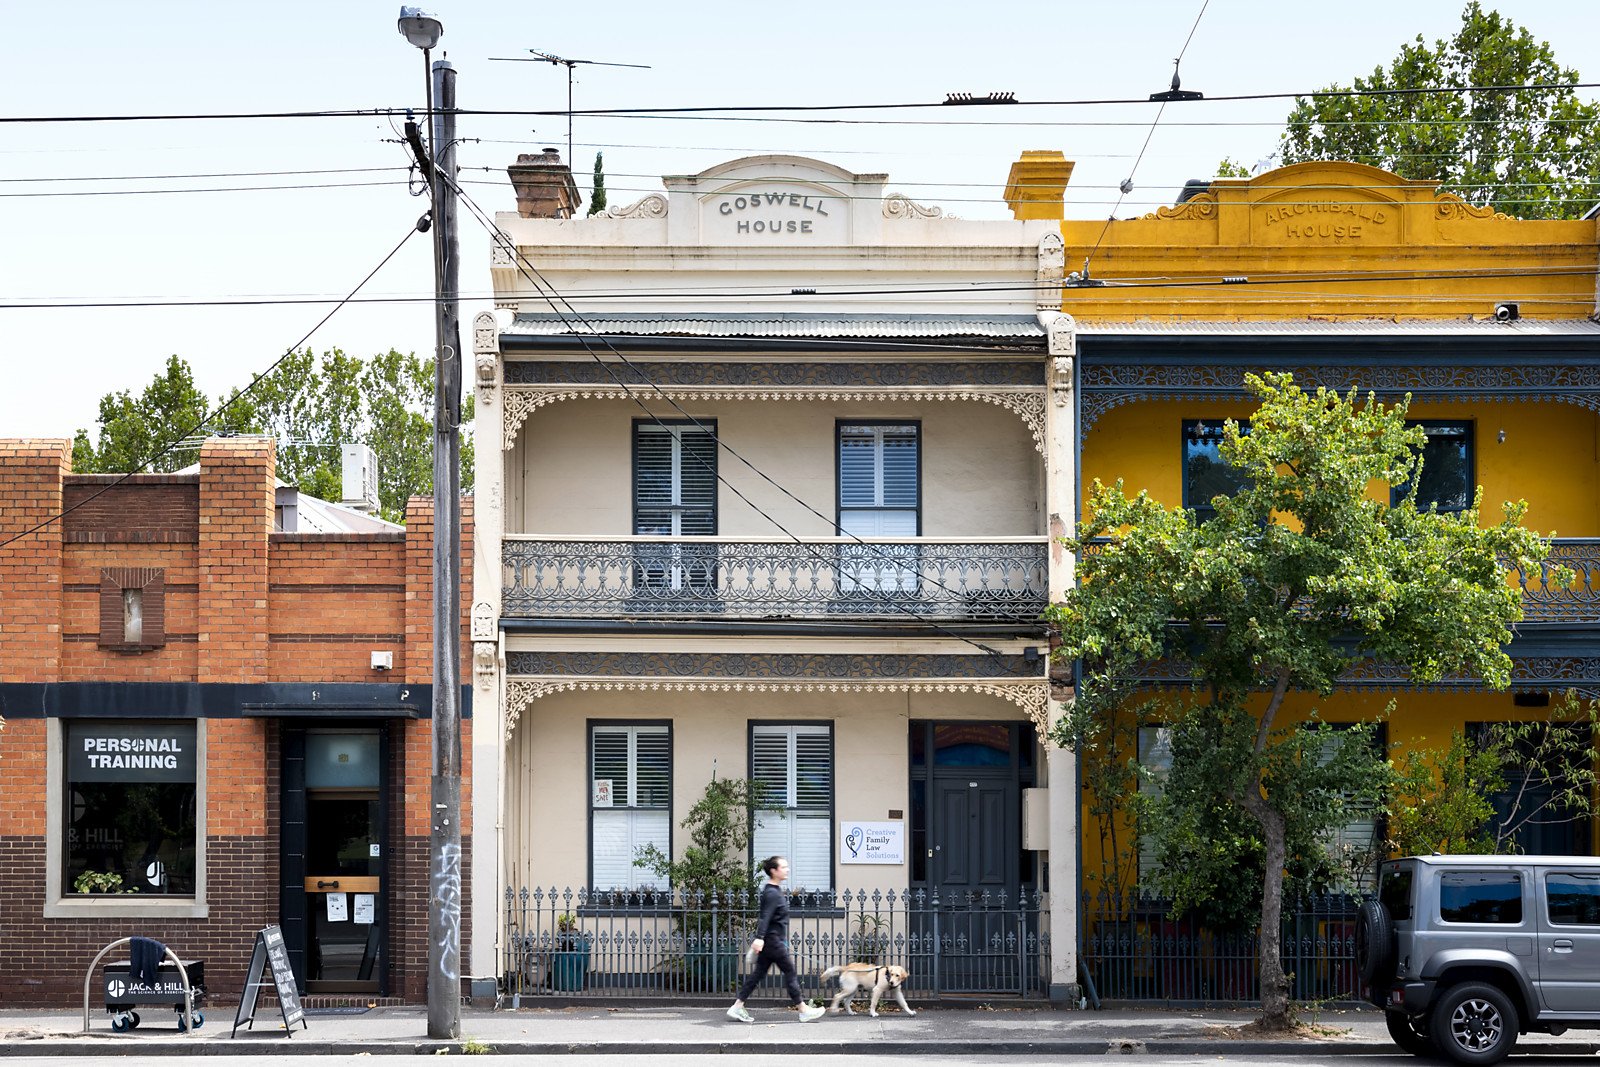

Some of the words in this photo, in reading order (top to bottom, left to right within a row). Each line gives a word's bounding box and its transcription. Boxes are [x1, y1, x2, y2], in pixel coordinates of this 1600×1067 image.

[1266, 201, 1386, 226] ARCHIBALD
[737, 220, 813, 233] HOUSE
[1287, 225, 1362, 238] HOUSE
[84, 738, 182, 752] PERSONAL
[88, 755, 177, 768] TRAINING
[85, 828, 124, 842] HILL
[866, 836, 890, 844] Family
[154, 982, 162, 991] &
[164, 982, 183, 991] HILL
